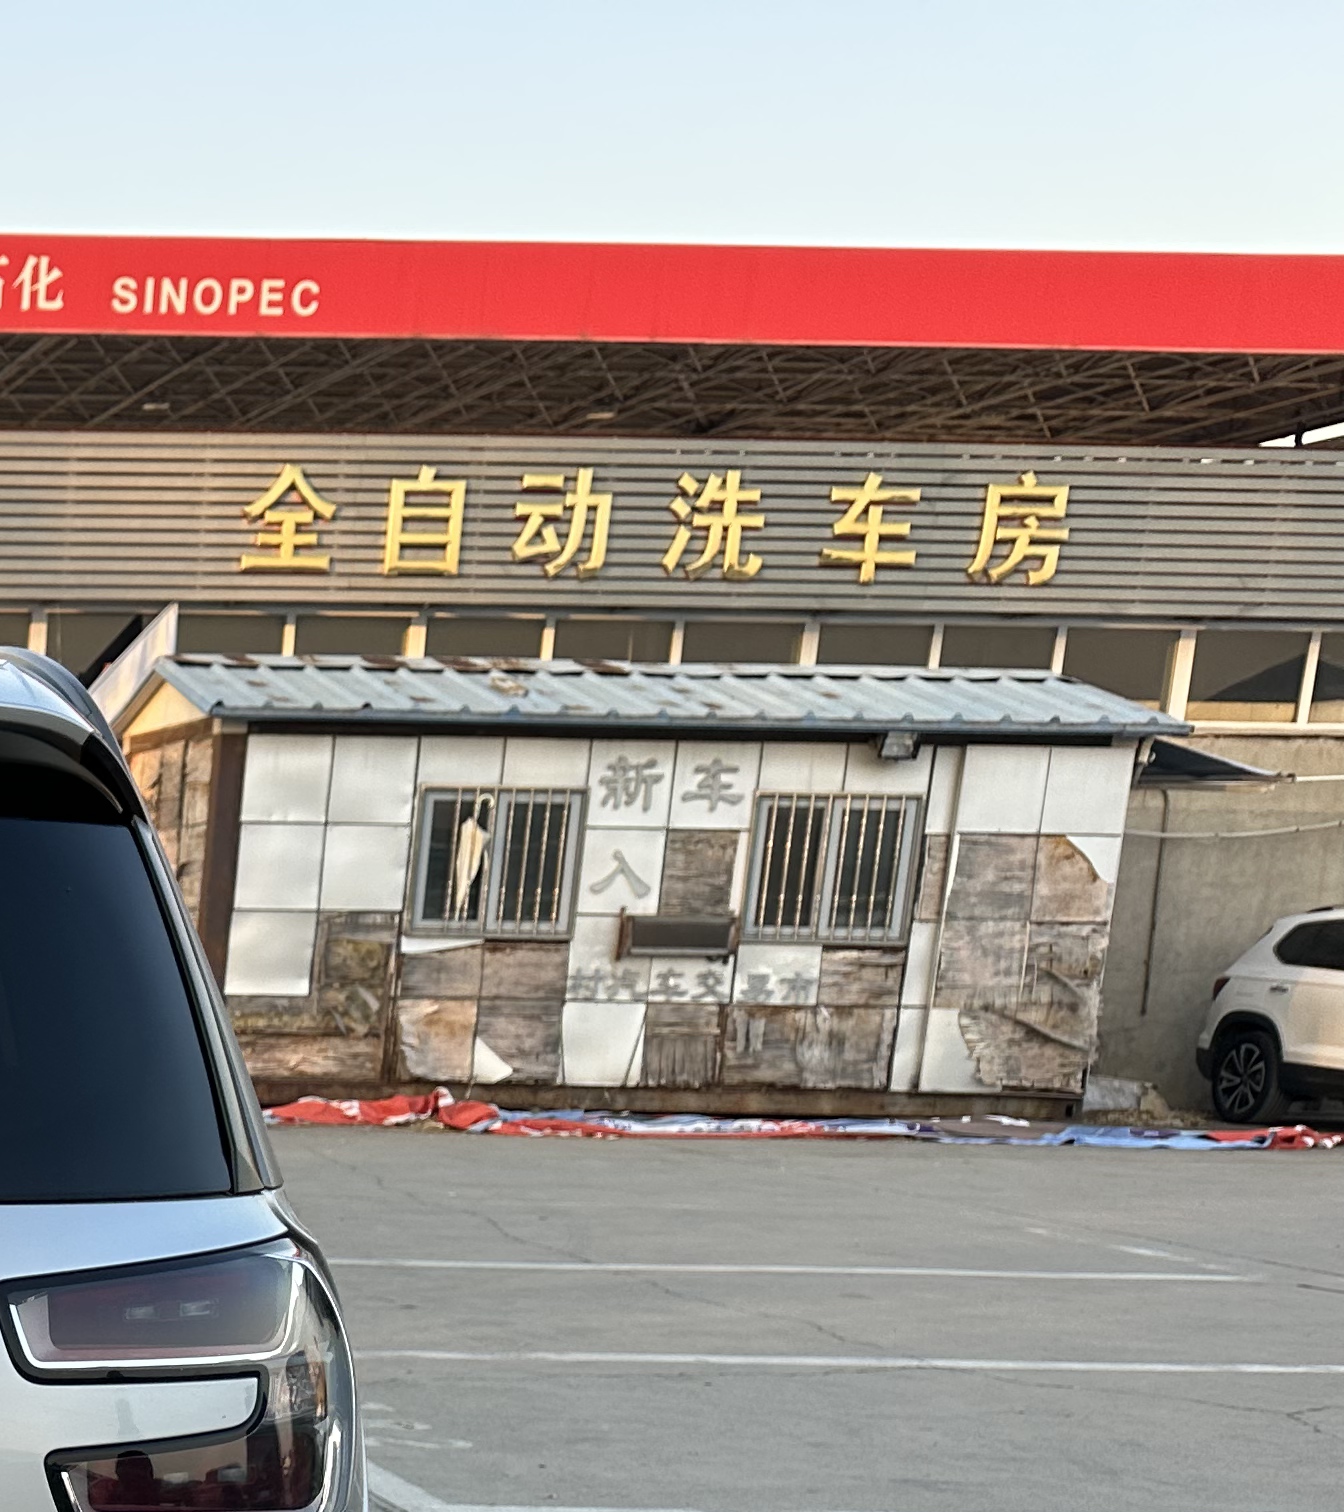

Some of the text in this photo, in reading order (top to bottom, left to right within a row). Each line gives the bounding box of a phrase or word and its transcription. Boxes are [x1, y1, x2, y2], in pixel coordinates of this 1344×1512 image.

[112, 276, 321, 317] SINOPEC
[239, 464, 1070, 586] 全自动洗车房
[598, 755, 745, 813] 新车
[589, 849, 651, 899] 入
